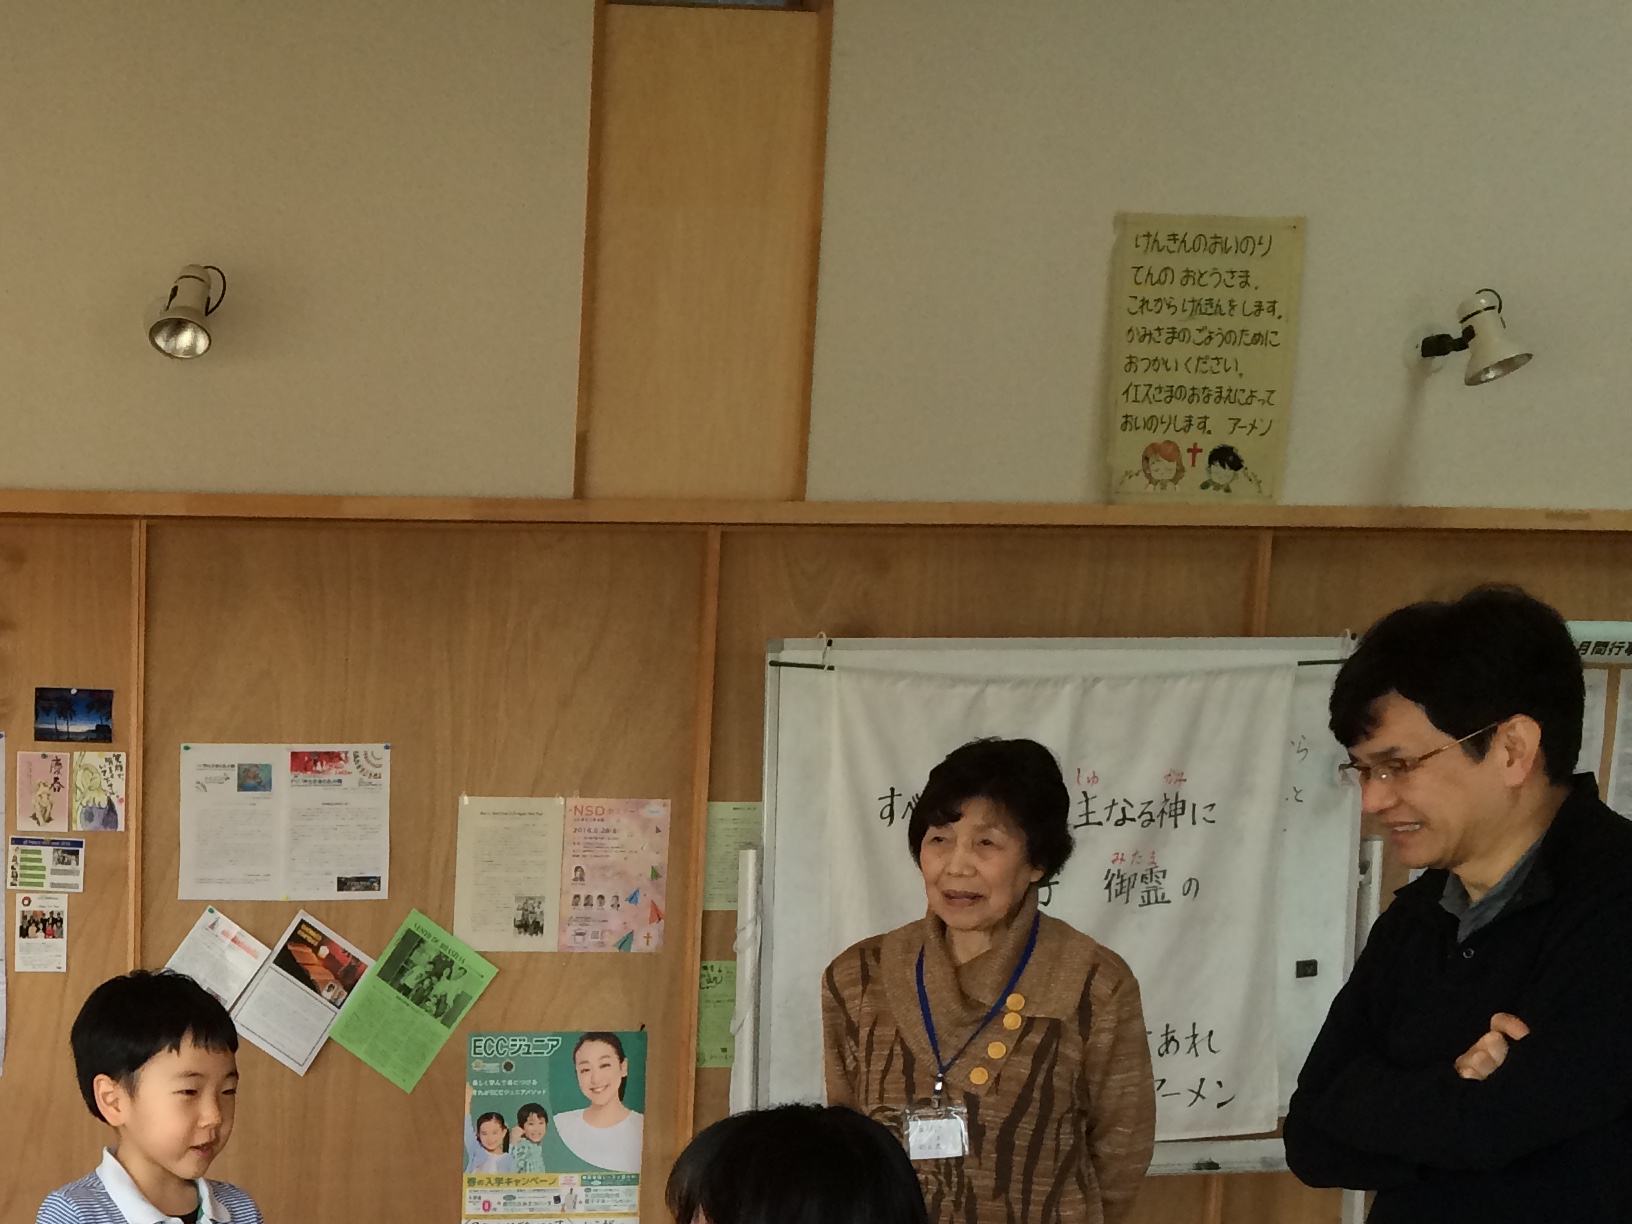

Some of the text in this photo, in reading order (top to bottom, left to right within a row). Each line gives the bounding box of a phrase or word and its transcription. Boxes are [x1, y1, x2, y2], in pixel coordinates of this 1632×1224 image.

[1134, 231, 1273, 257] けんきんのおいのり
[1228, 417, 1273, 437] アーメン
[1076, 768, 1100, 786] しゅ
[573, 805, 605, 817] NSD
[1073, 791, 1217, 830] 主なる神に
[1104, 866, 1172, 907] 御霊
[1182, 876, 1200, 900] の
[471, 1036, 562, 1057] ECCジュニア
[1147, 1022, 1221, 1058] あれ
